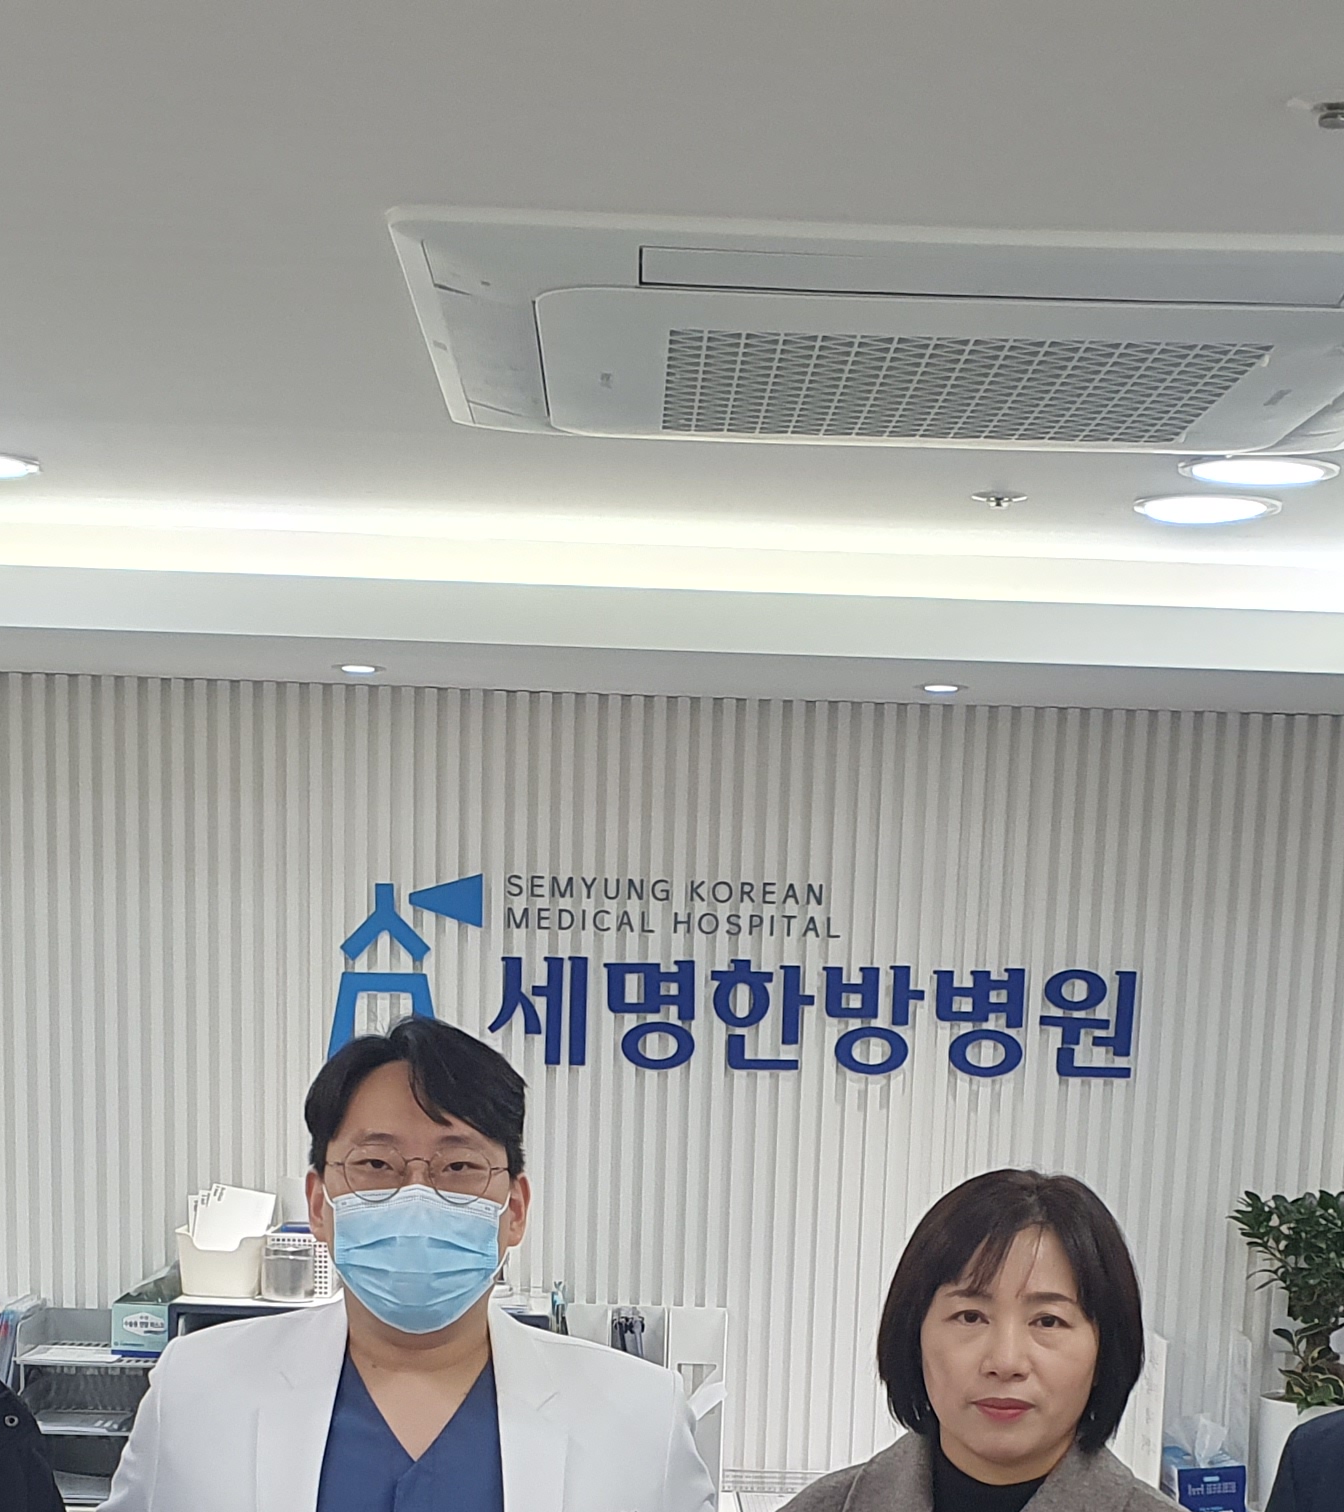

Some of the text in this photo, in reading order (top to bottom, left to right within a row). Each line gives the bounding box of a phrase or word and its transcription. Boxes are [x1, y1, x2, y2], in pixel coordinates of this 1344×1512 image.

[506, 874, 824, 906] SEMYUNG KOREAN
[506, 907, 841, 939] MEDICAL HOSPITAL
[489, 955, 1138, 1080] 세명한방병원
